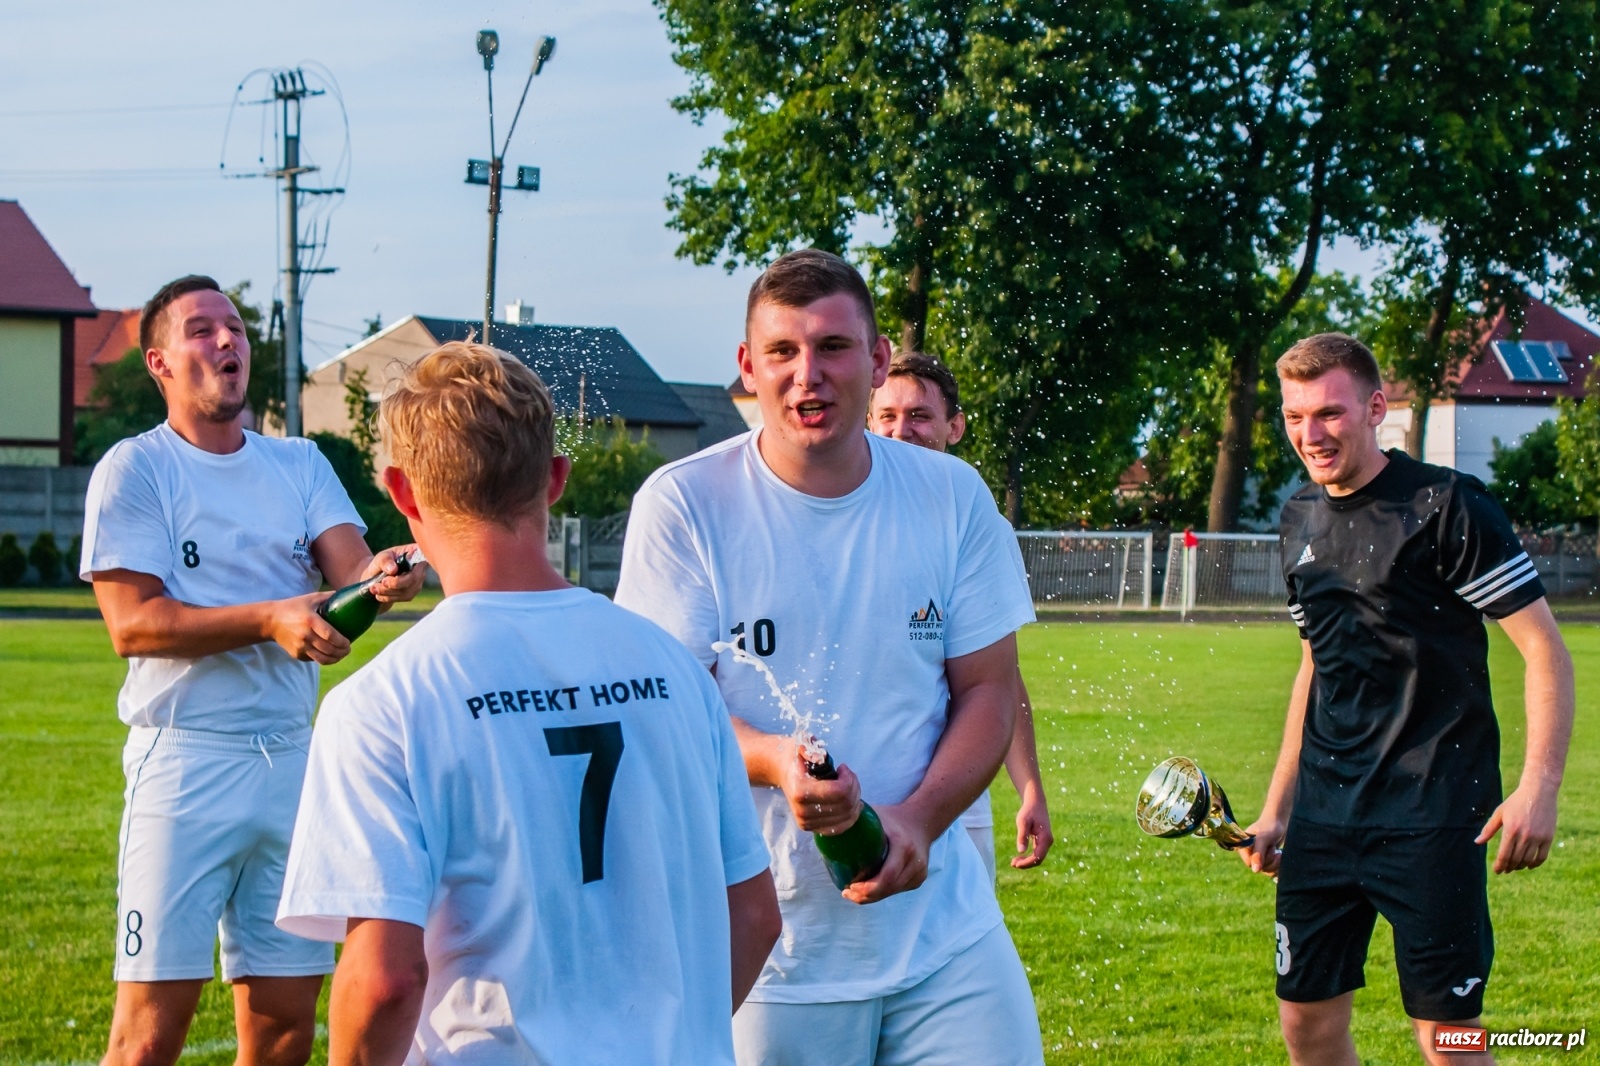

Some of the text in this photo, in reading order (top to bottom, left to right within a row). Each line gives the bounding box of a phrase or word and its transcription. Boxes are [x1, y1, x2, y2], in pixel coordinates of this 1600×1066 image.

[182, 540, 200, 569] 8
[730, 618, 776, 657] 10
[466, 677, 669, 720] PERFEKT HOME
[543, 721, 625, 885] 7
[125, 910, 143, 956] 8
